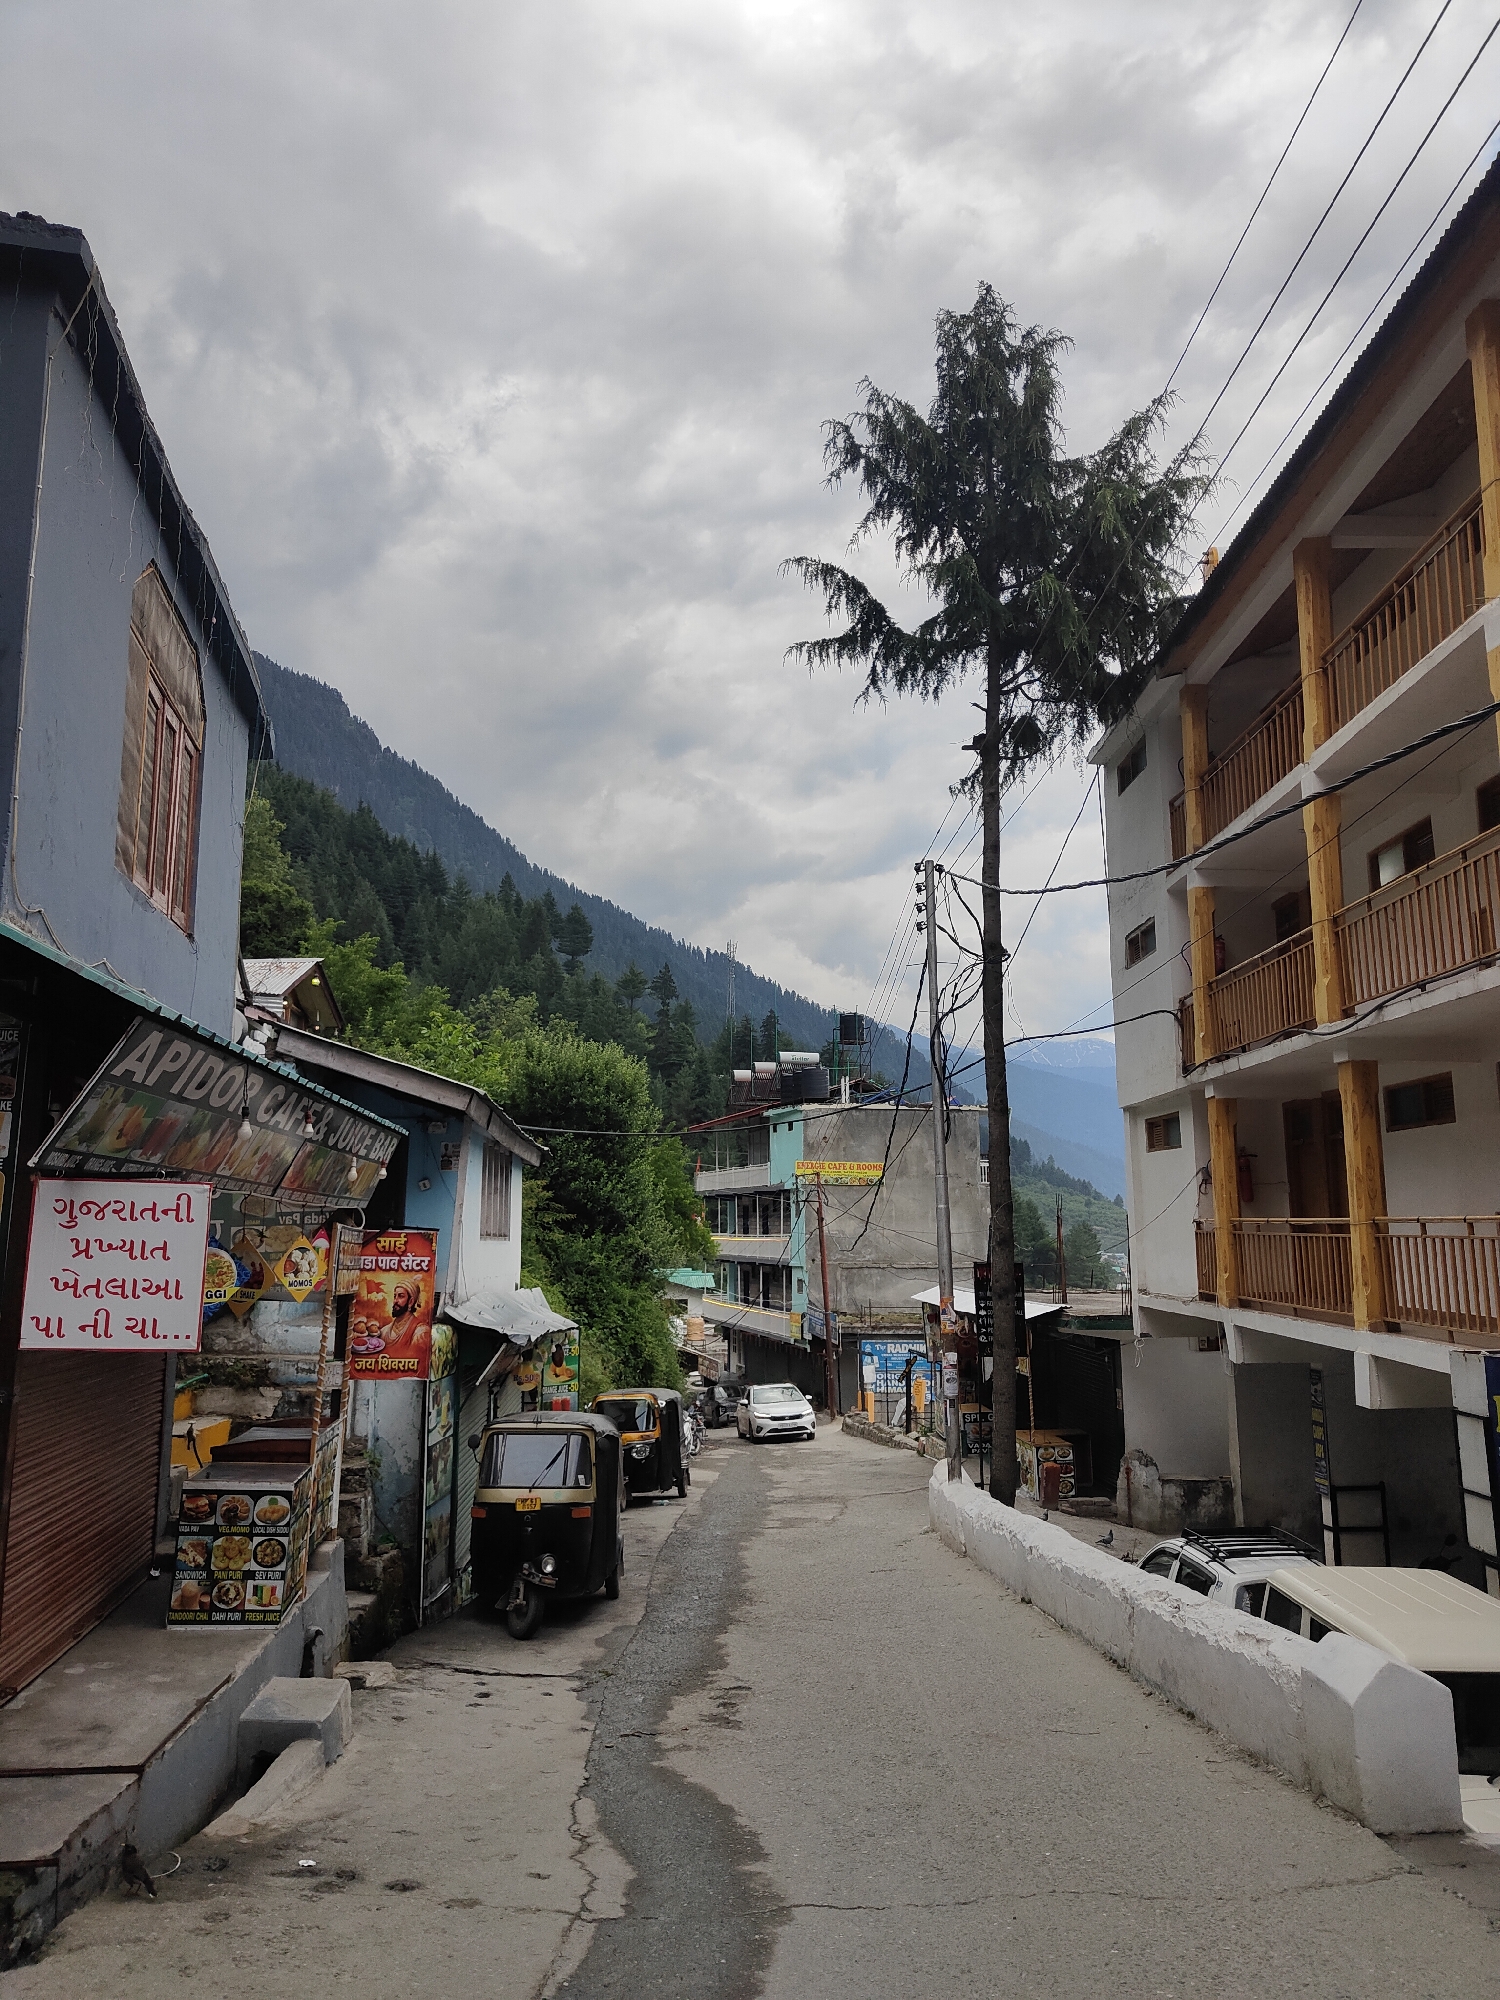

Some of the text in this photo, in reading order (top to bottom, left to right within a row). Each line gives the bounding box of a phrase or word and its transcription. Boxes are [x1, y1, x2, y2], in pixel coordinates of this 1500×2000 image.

[110, 1030, 398, 1164] APIDOR CAFE & JUICE BAR
[828, 1162, 848, 1171] CAFE
[849, 1162, 855, 1171] &
[856, 1163, 883, 1172] ROOMS
[53, 1193, 195, 1229] ગુજરાતની
[376, 1232, 408, 1255] साई
[70, 1237, 171, 1261] પ્રખ્યાત
[378, 1256, 400, 1271] पाव
[401, 1252, 431, 1271] सेंटर
[50, 1268, 184, 1300] ખેતલાઆ
[287, 1279, 313, 1288] MOMOS
[354, 1353, 419, 1372] जय शिवराय
[174, 1570, 207, 1580] SANDWICH
[213, 1570, 244, 1580] PANI PURI
[254, 1570, 282, 1580] SEV PURI
[168, 1611, 196, 1621] TANDOORI
[211, 1611, 242, 1621] DAHI PURI
[244, 1612, 280, 1622] FRESH JUICE
